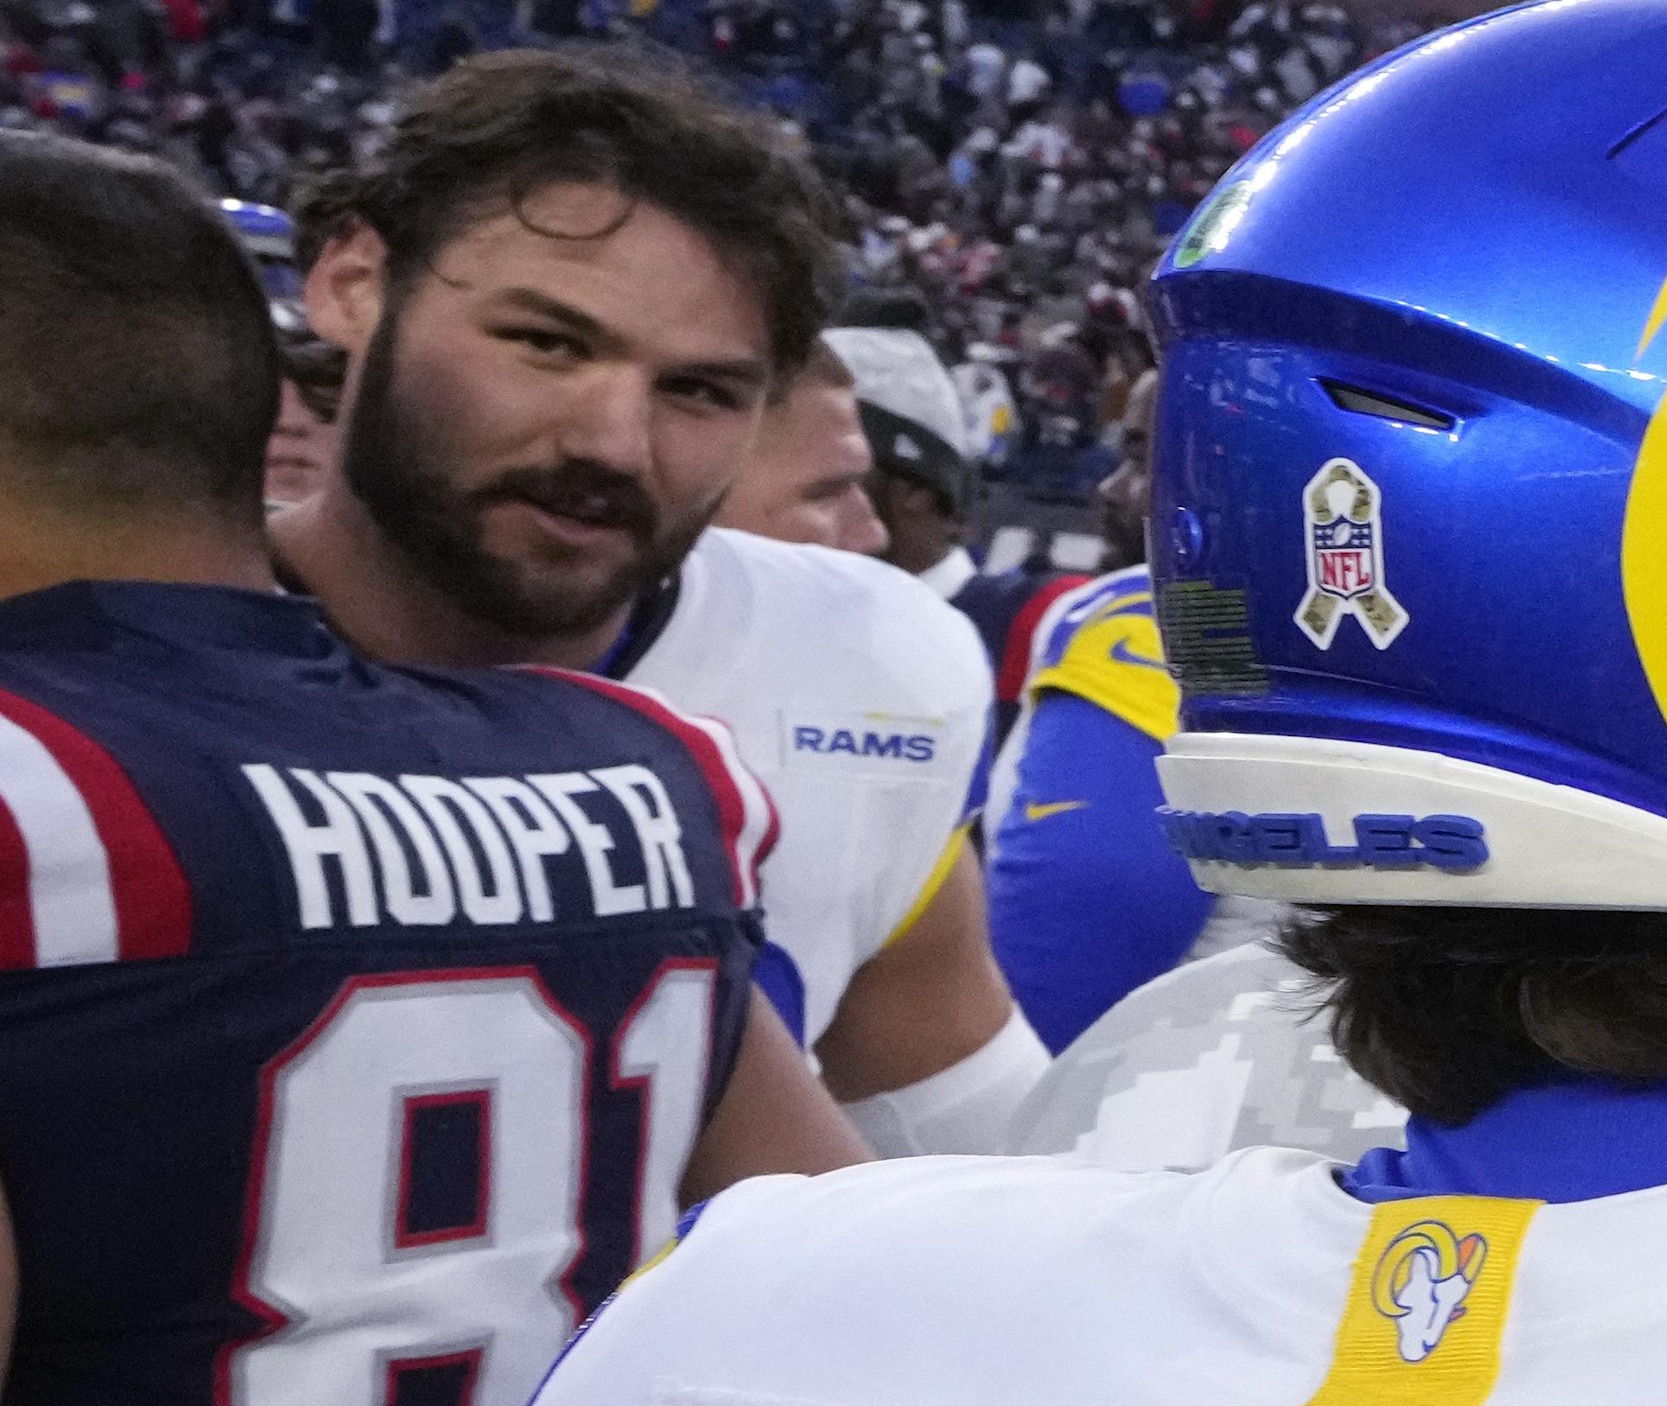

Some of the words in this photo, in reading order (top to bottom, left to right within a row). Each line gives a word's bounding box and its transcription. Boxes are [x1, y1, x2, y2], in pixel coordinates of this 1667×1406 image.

[1319, 551, 1370, 592] NFL
[794, 727, 935, 763] RAMS
[243, 763, 695, 930] HOOPER
